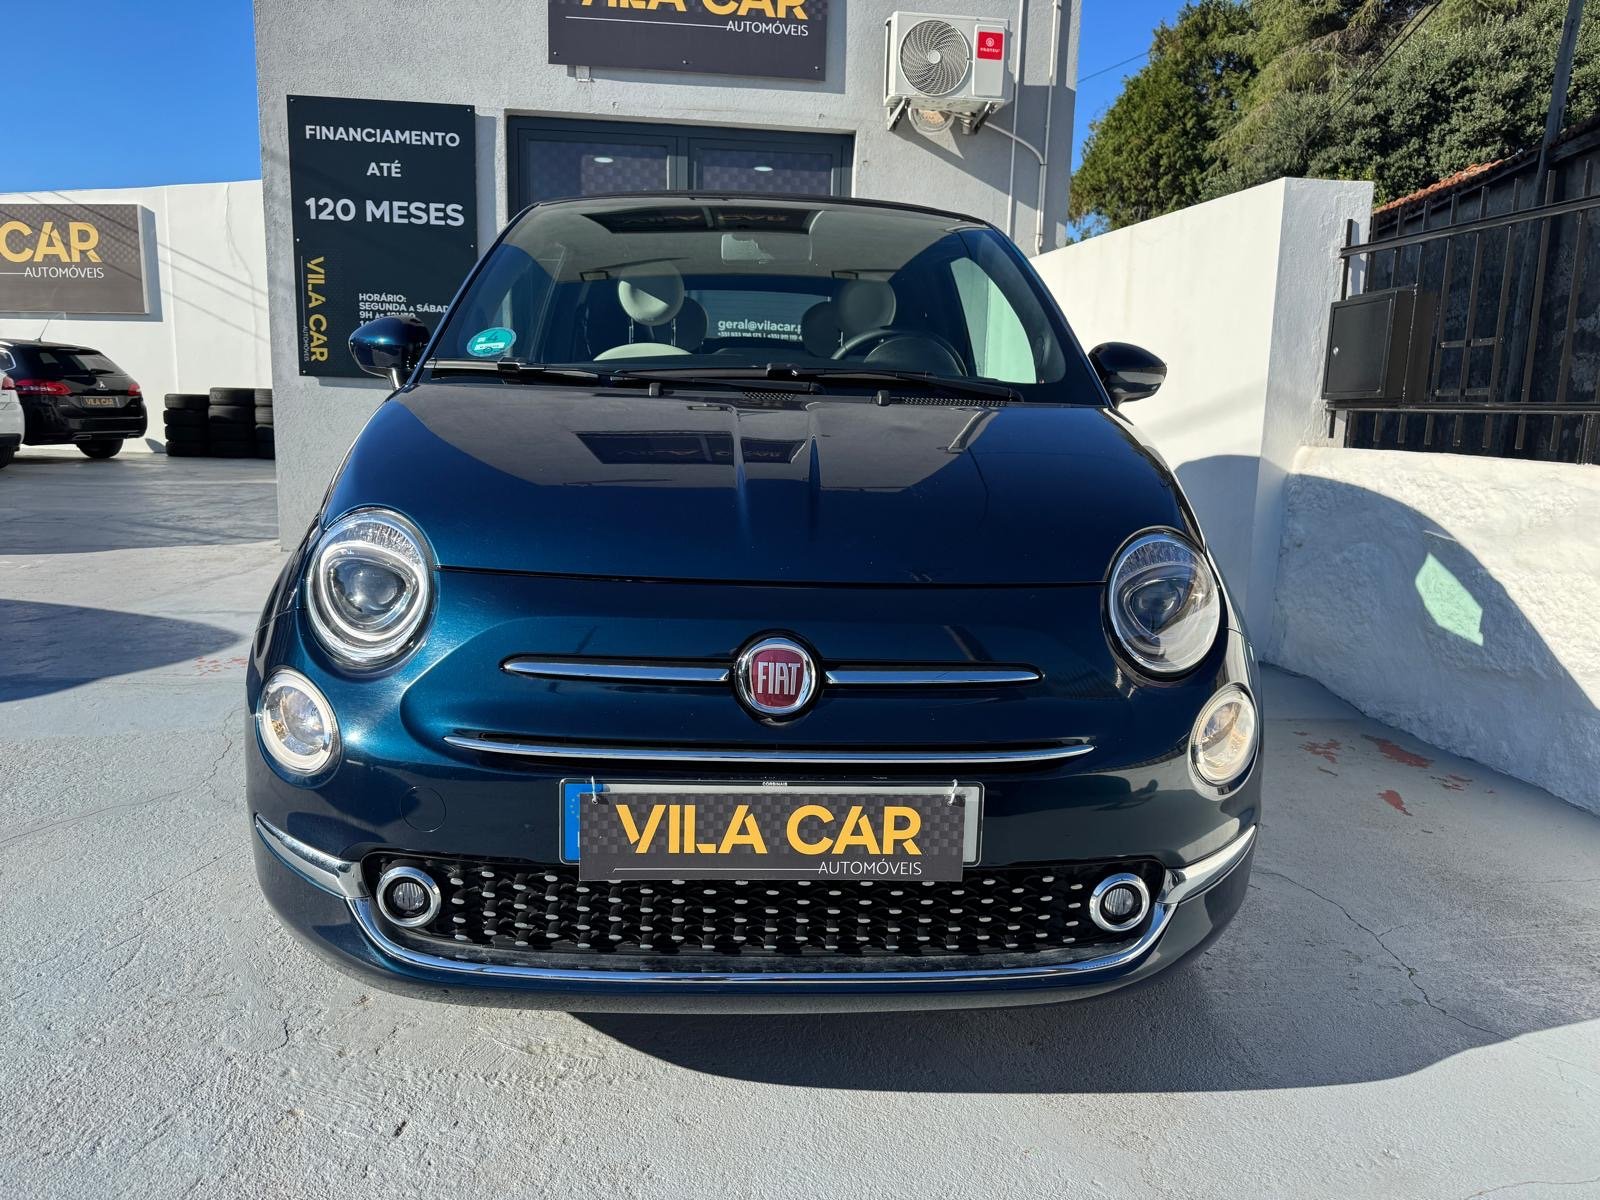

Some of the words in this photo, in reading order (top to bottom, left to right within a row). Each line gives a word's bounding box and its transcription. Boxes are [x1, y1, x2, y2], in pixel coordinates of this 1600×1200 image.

[726, 20, 809, 36] AUTOMÓVEIS
[305, 125, 461, 147] FINANCIAMENTO
[366, 160, 402, 178] ATÉ
[305, 197, 356, 222] 120
[365, 200, 465, 227] MESES
[0, 221, 102, 263] CAR
[24, 265, 105, 279] AUTOMÓVEIS
[306, 256, 326, 309] VILA
[359, 292, 407, 303] HORÁRIO:
[359, 302, 407, 312] SEGUNDA
[416, 303, 449, 313] SÁBAD
[359, 311, 373, 319] 9H
[308, 314, 329, 362] CAR
[757, 661, 801, 696] FIAT
[615, 804, 768, 854] VILA
[786, 804, 923, 856] CAR
[818, 858, 923, 876] AUTOMÓVEIS
